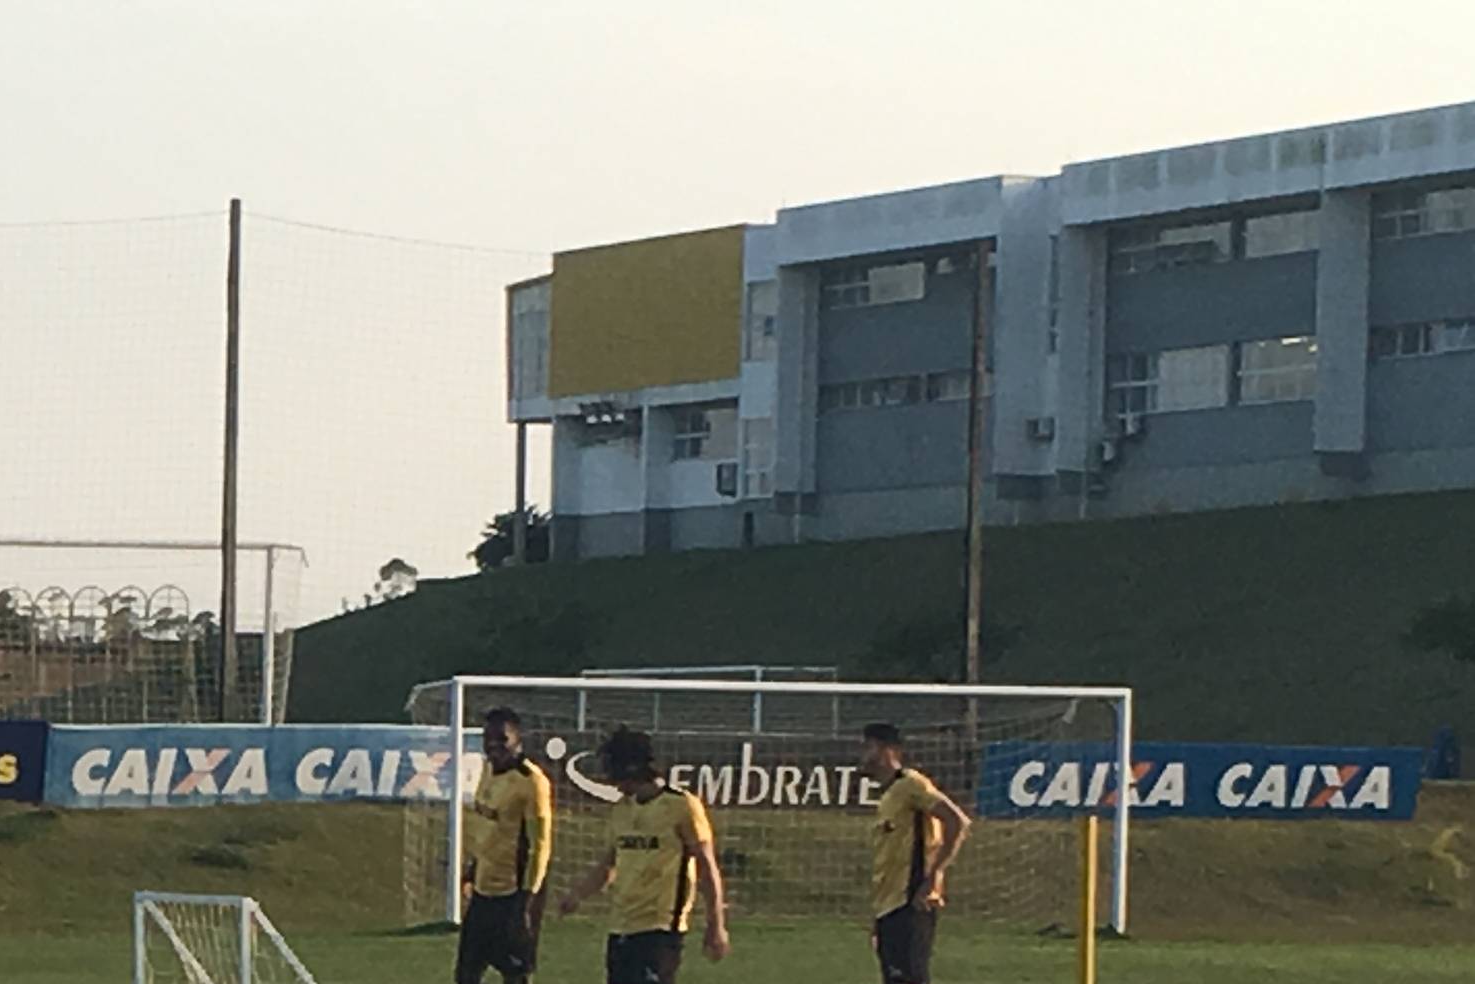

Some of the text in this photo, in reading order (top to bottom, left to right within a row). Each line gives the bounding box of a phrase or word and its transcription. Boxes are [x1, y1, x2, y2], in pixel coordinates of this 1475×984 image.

[72, 748, 269, 796] CAIXA
[1008, 760, 1391, 810] CAIXA CAIXA
